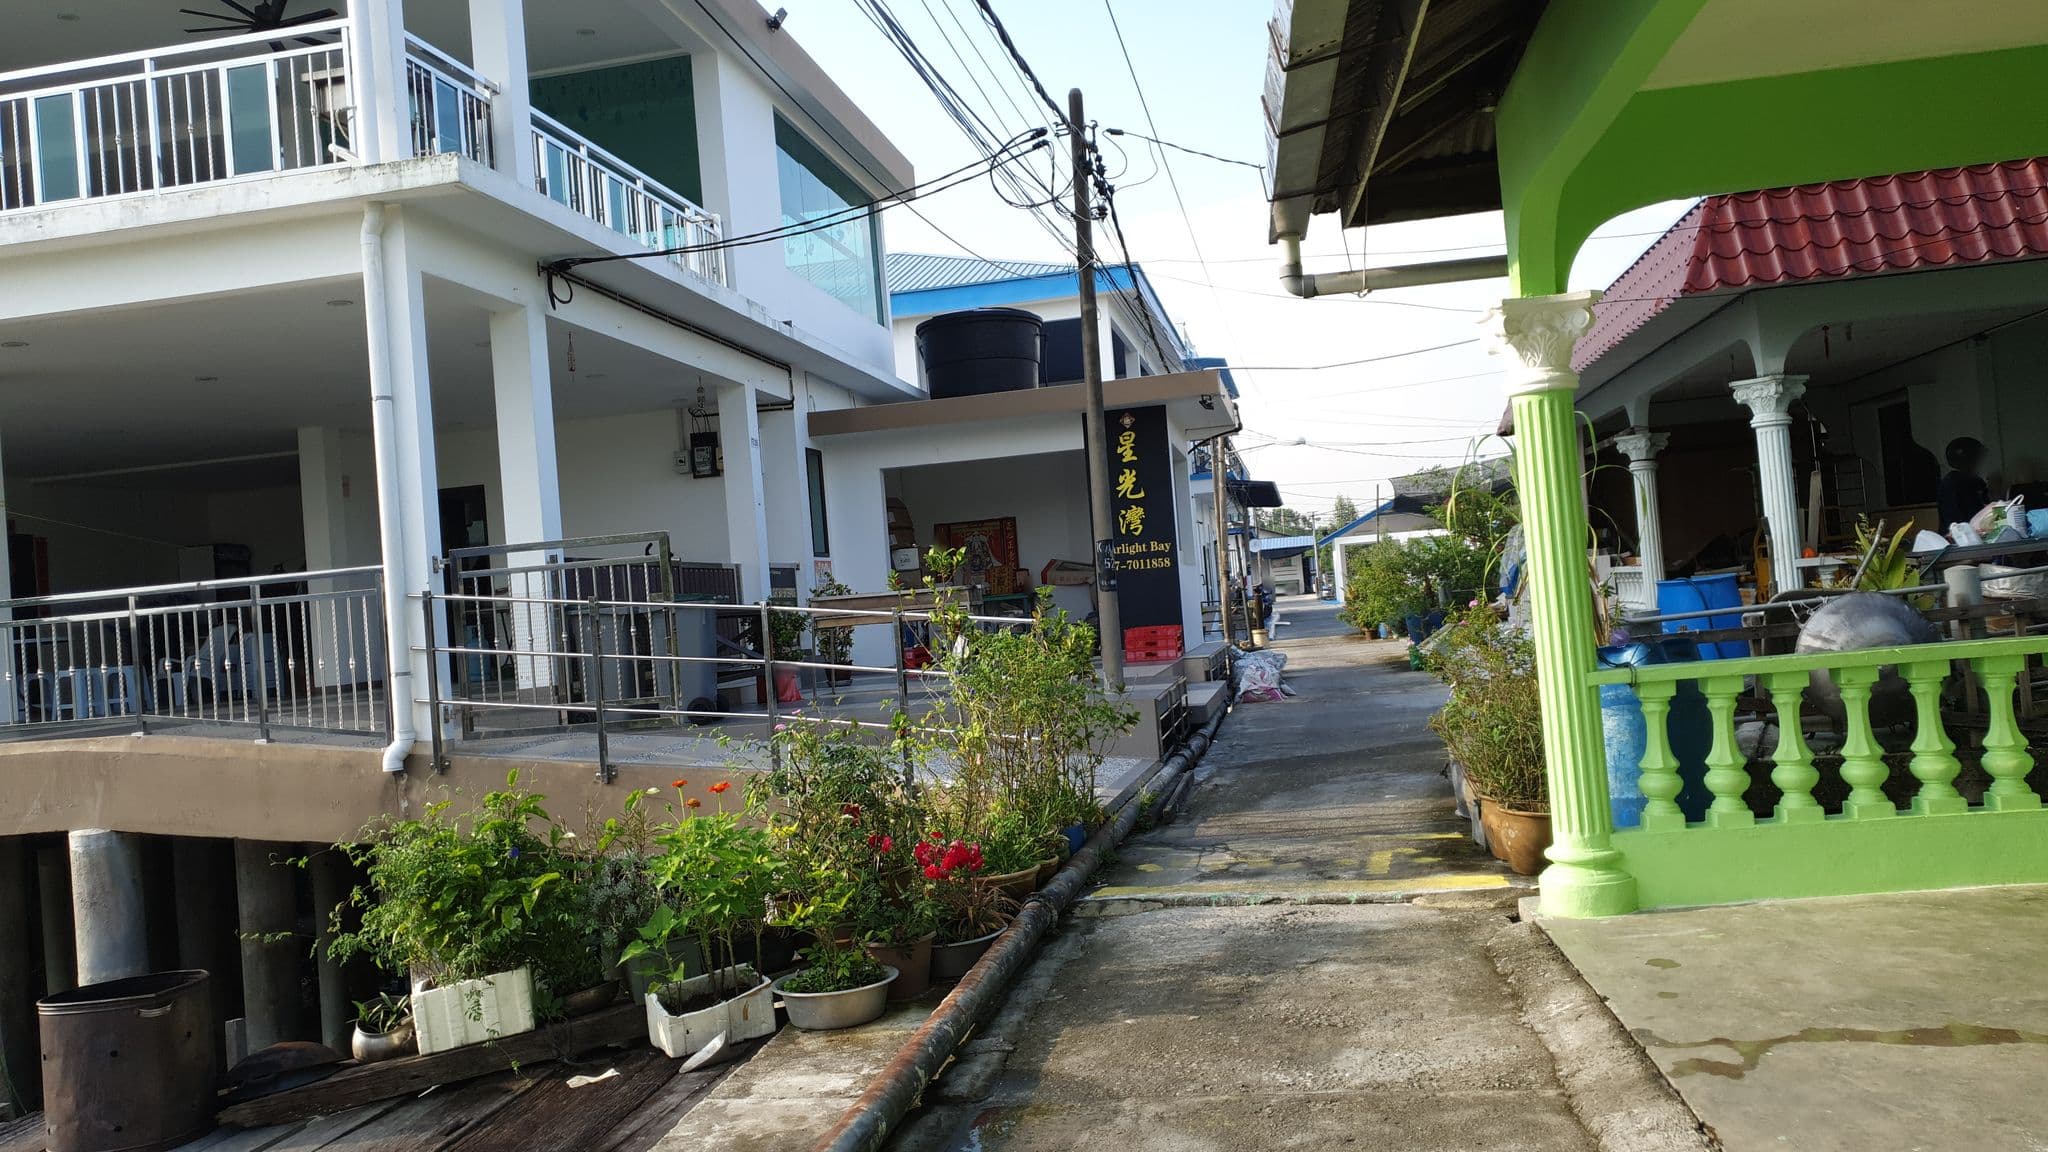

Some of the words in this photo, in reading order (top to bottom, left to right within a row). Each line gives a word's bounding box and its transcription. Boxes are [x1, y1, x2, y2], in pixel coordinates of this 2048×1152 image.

[1116, 431, 1145, 536] 星光灣
[1150, 541, 1171, 552] Bay
